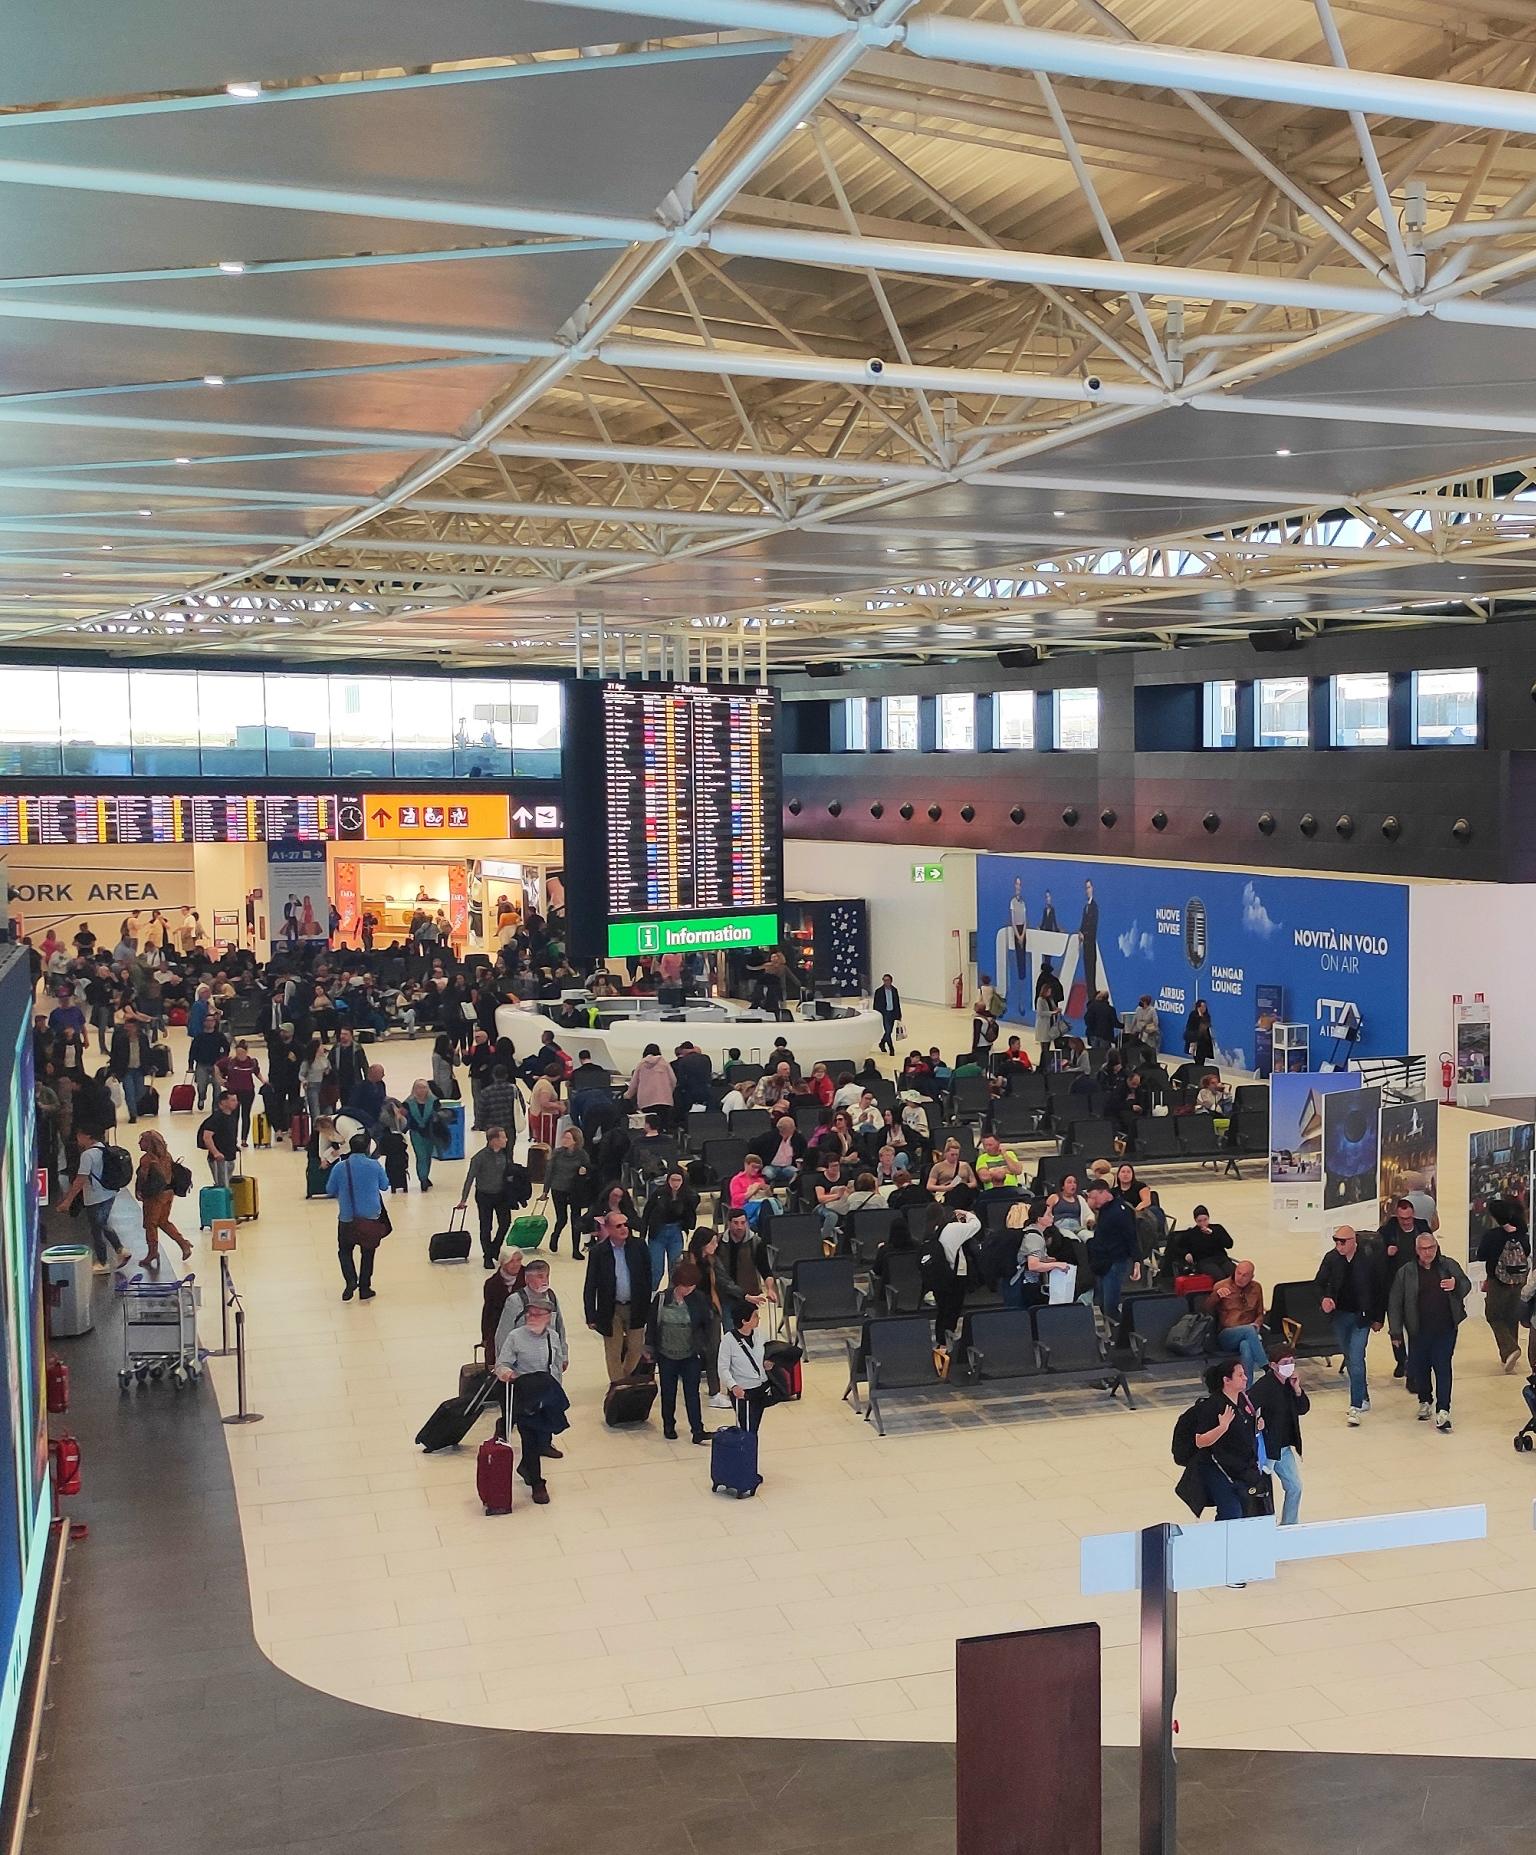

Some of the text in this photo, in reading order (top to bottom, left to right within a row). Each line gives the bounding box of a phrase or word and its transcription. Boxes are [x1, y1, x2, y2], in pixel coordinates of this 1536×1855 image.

[8, 883, 159, 902] ORK AREA
[1156, 908, 1180, 921] NUOVE
[666, 925, 751, 946] Information
[1158, 922, 1180, 935] DIVISE
[1294, 928, 1388, 956] NOVITÀ IN VOLO
[1321, 953, 1359, 974] ON AIR
[1211, 965, 1243, 981] HANGAR
[1160, 986, 1184, 1000] AIRBUS
[1211, 980, 1242, 995] LOUNGE
[1153, 999, 1184, 1014] A320NEO
[1317, 998, 1363, 1026] ITA
